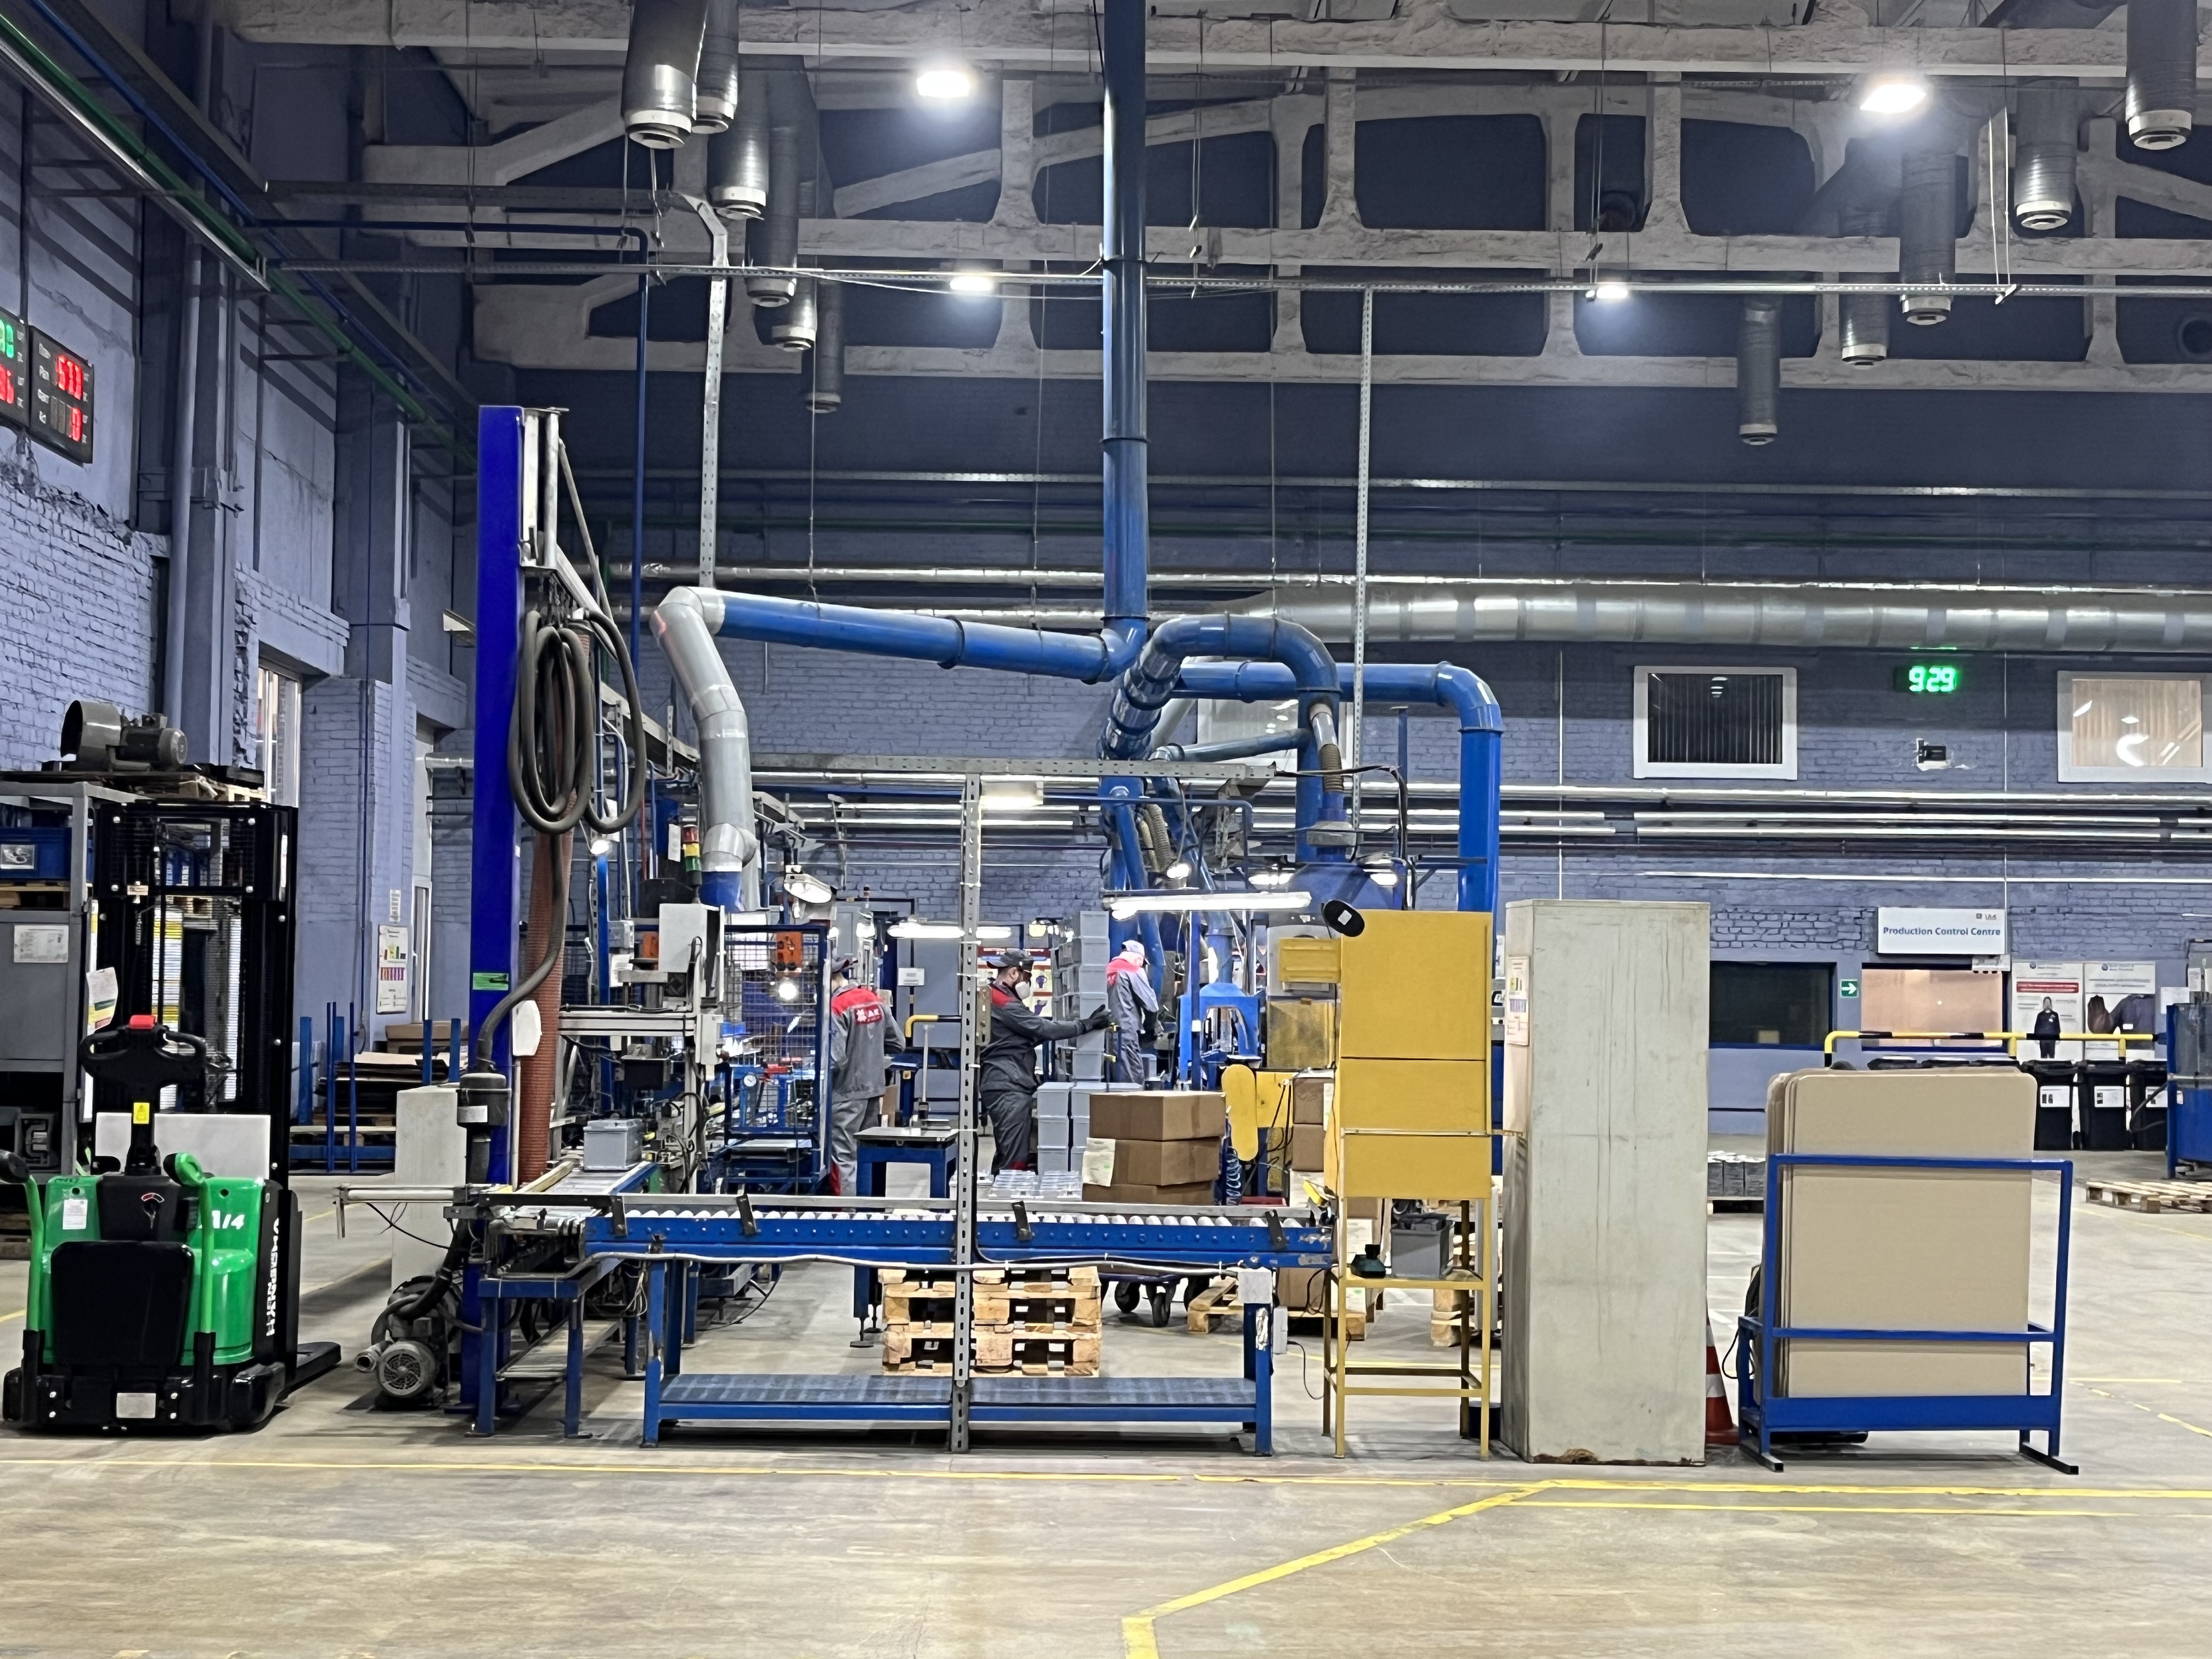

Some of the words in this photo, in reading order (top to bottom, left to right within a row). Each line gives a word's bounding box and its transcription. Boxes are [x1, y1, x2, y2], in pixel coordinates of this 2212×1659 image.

[1883, 927, 1933, 936] Production
[1935, 927, 1968, 936] Control
[1971, 928, 2001, 936] Centre
